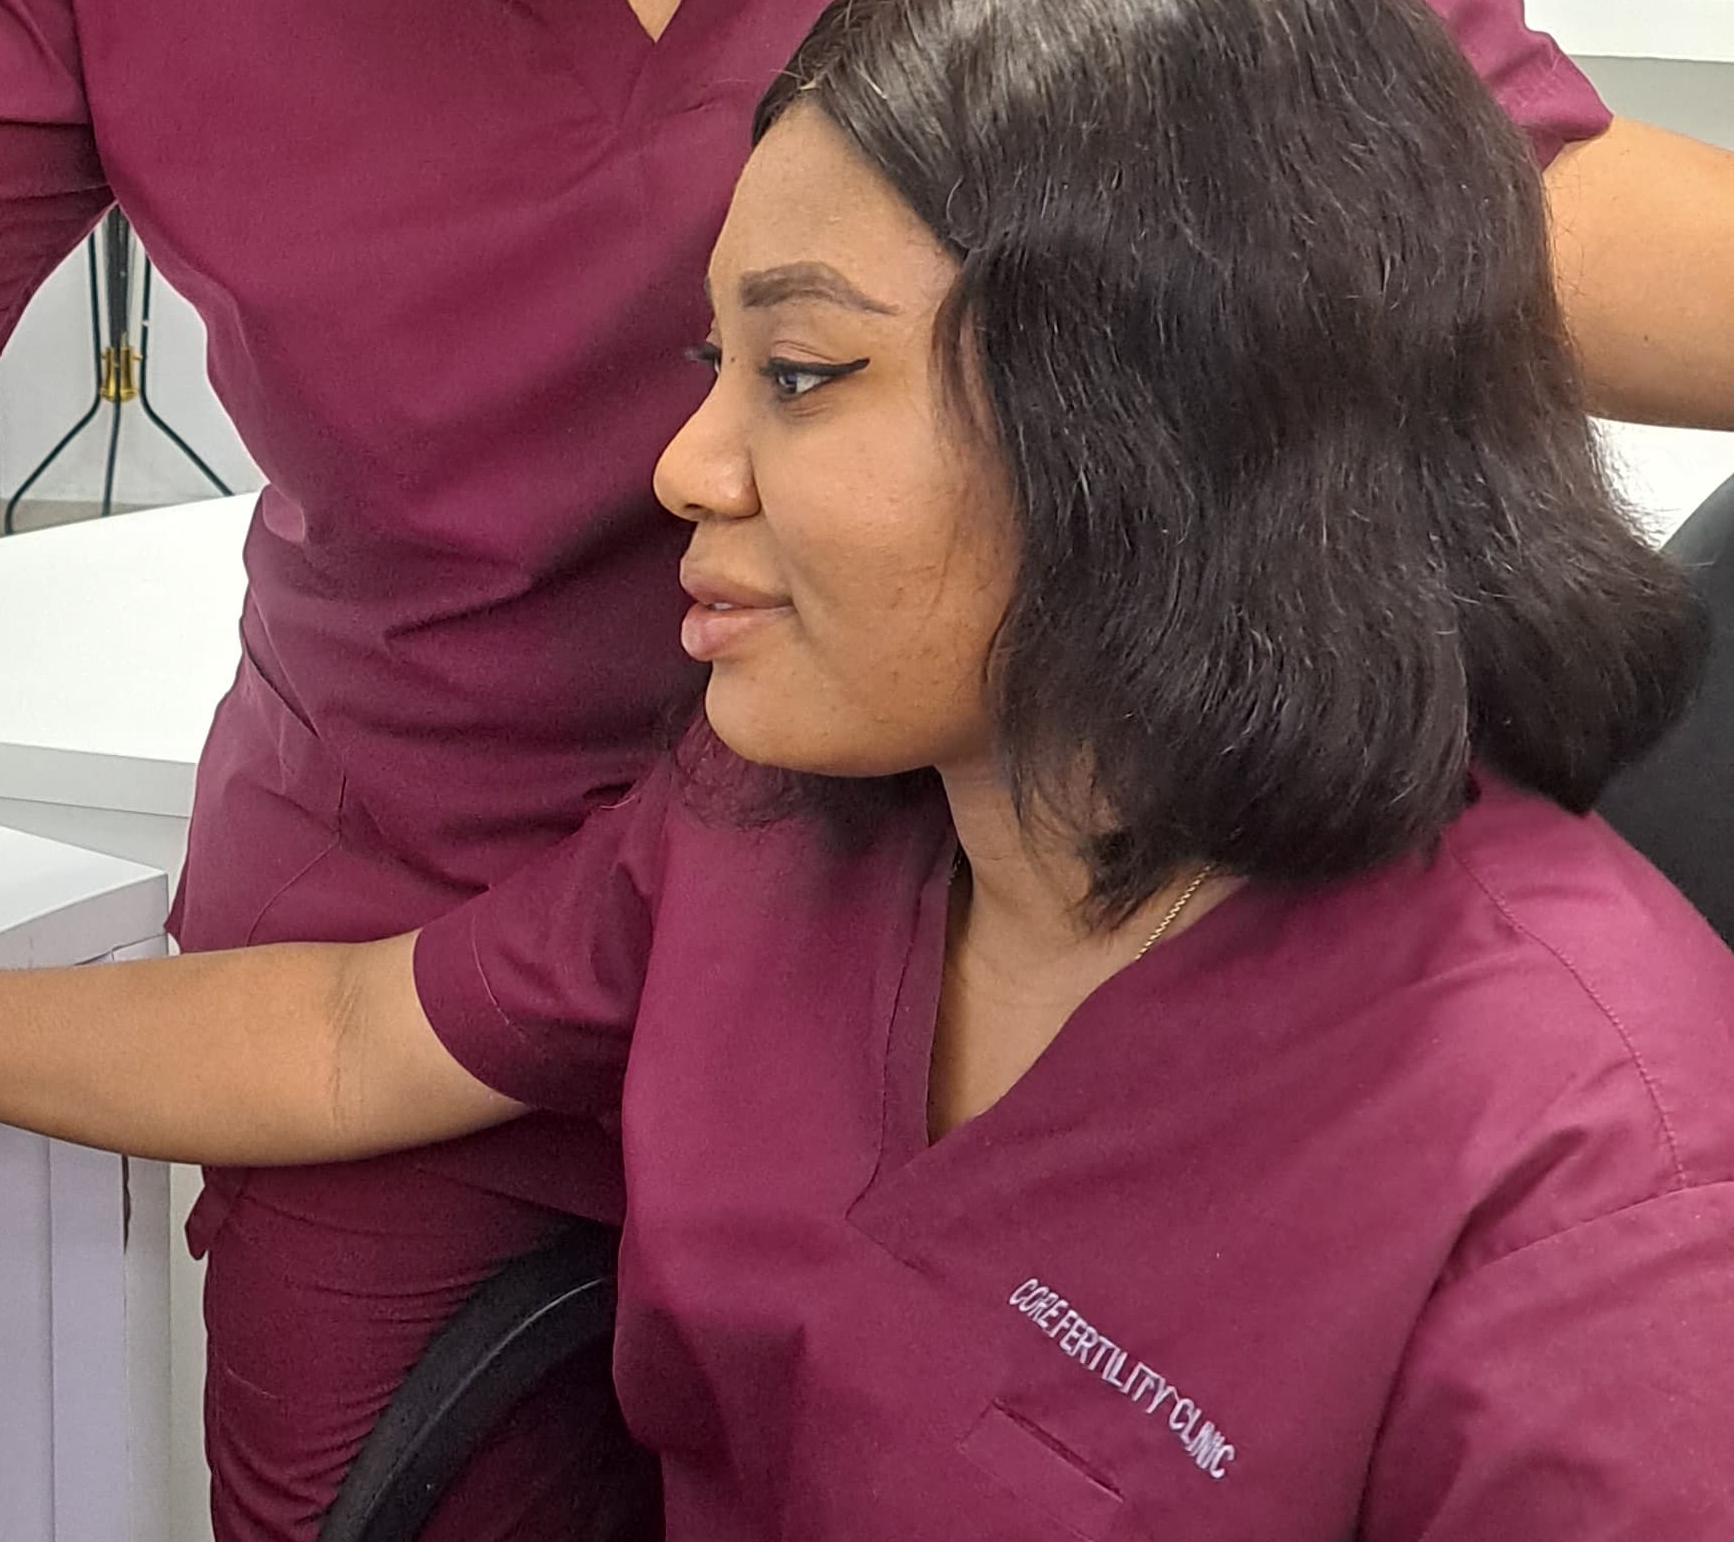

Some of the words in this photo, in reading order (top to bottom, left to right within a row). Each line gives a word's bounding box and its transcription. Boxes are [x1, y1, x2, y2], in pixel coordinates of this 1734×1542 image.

[1009, 1278, 1068, 1331] CORE
[1049, 1309, 1177, 1414] FERTILITY
[1167, 1397, 1236, 1479] CLINIC
